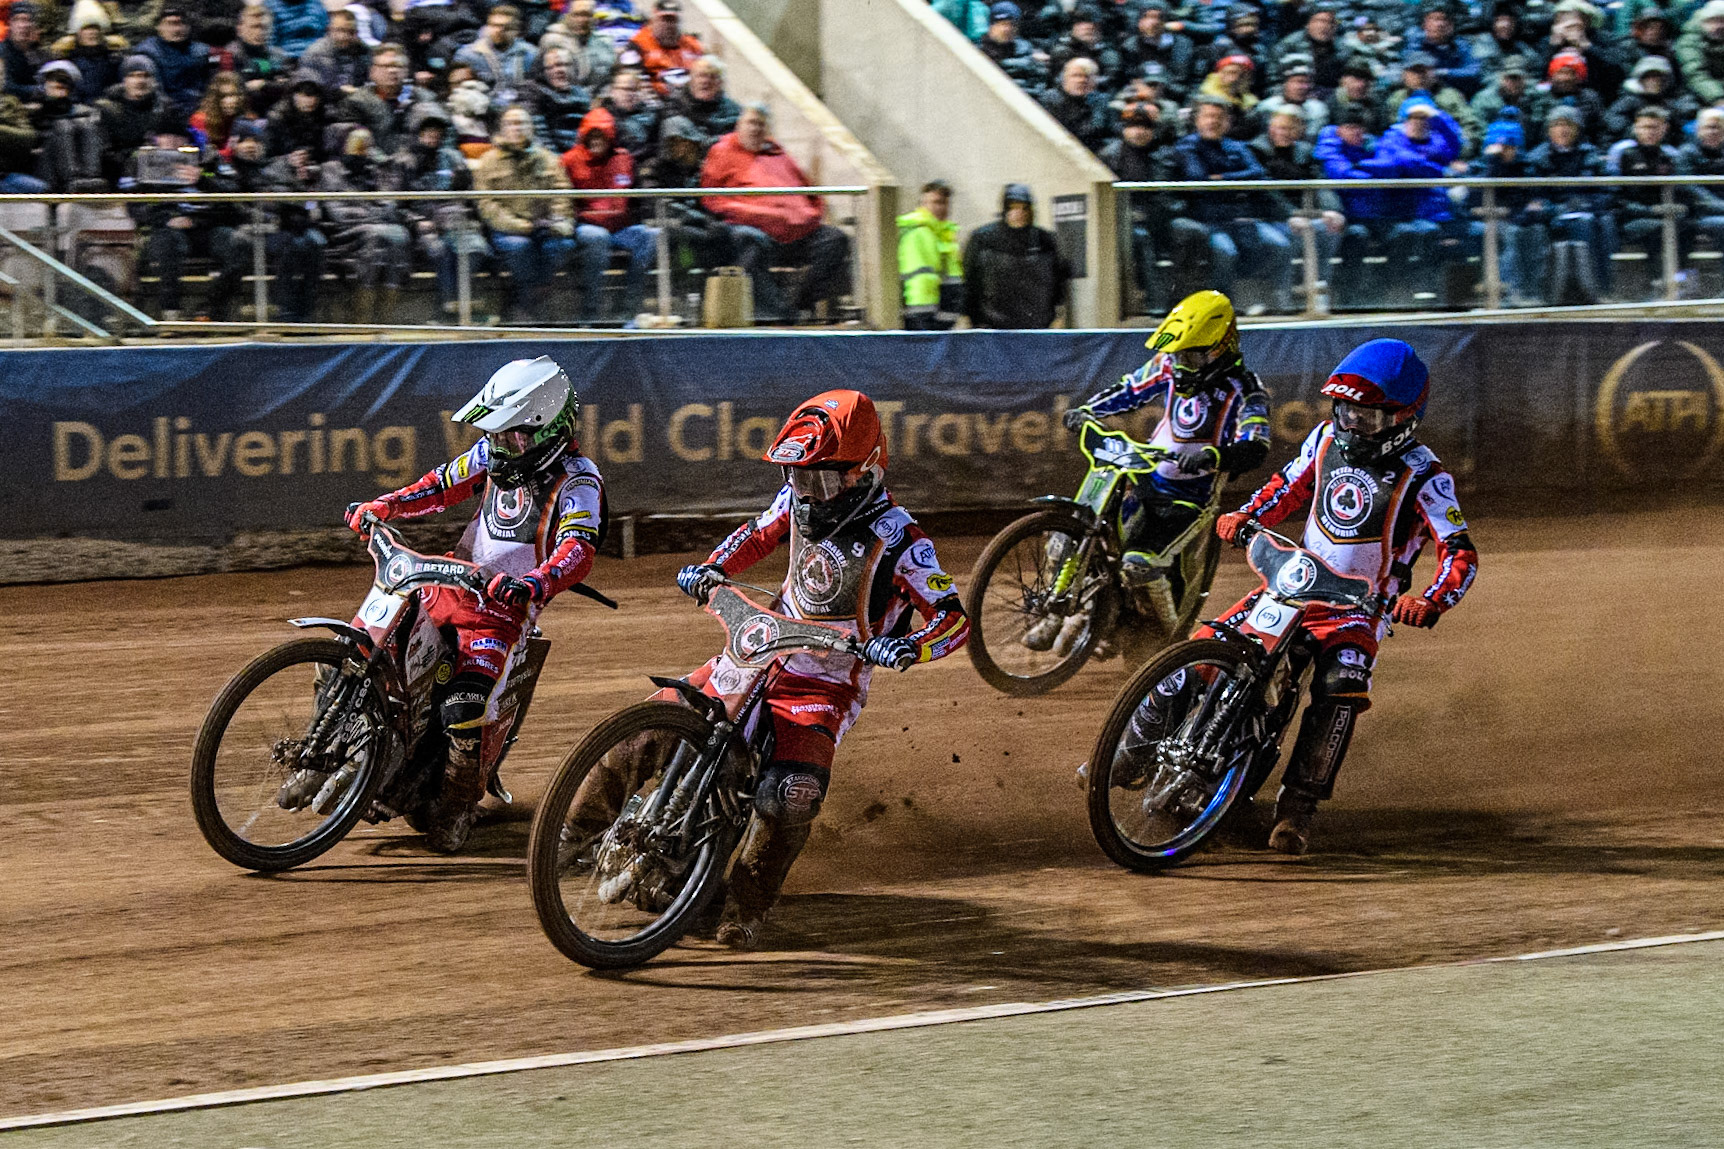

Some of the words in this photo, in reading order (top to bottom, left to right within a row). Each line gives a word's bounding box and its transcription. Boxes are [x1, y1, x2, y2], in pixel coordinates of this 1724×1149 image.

[53, 413, 417, 489] Delivering
[440, 404, 644, 464] Wld
[1330, 466, 1353, 478] PETER
[1354, 468, 1379, 494] CRAVEN
[1382, 471, 1396, 484] 2
[486, 513, 516, 538] MEMORIAL
[1321, 515, 1359, 537] MEMORIAL
[822, 540, 848, 567] CRAVEN
[851, 541, 866, 558] 9
[423, 563, 465, 575] BETARD
[794, 587, 832, 613] MEMORIAL
[1261, 611, 1276, 622] ATPI
[787, 787, 820, 799] STS
